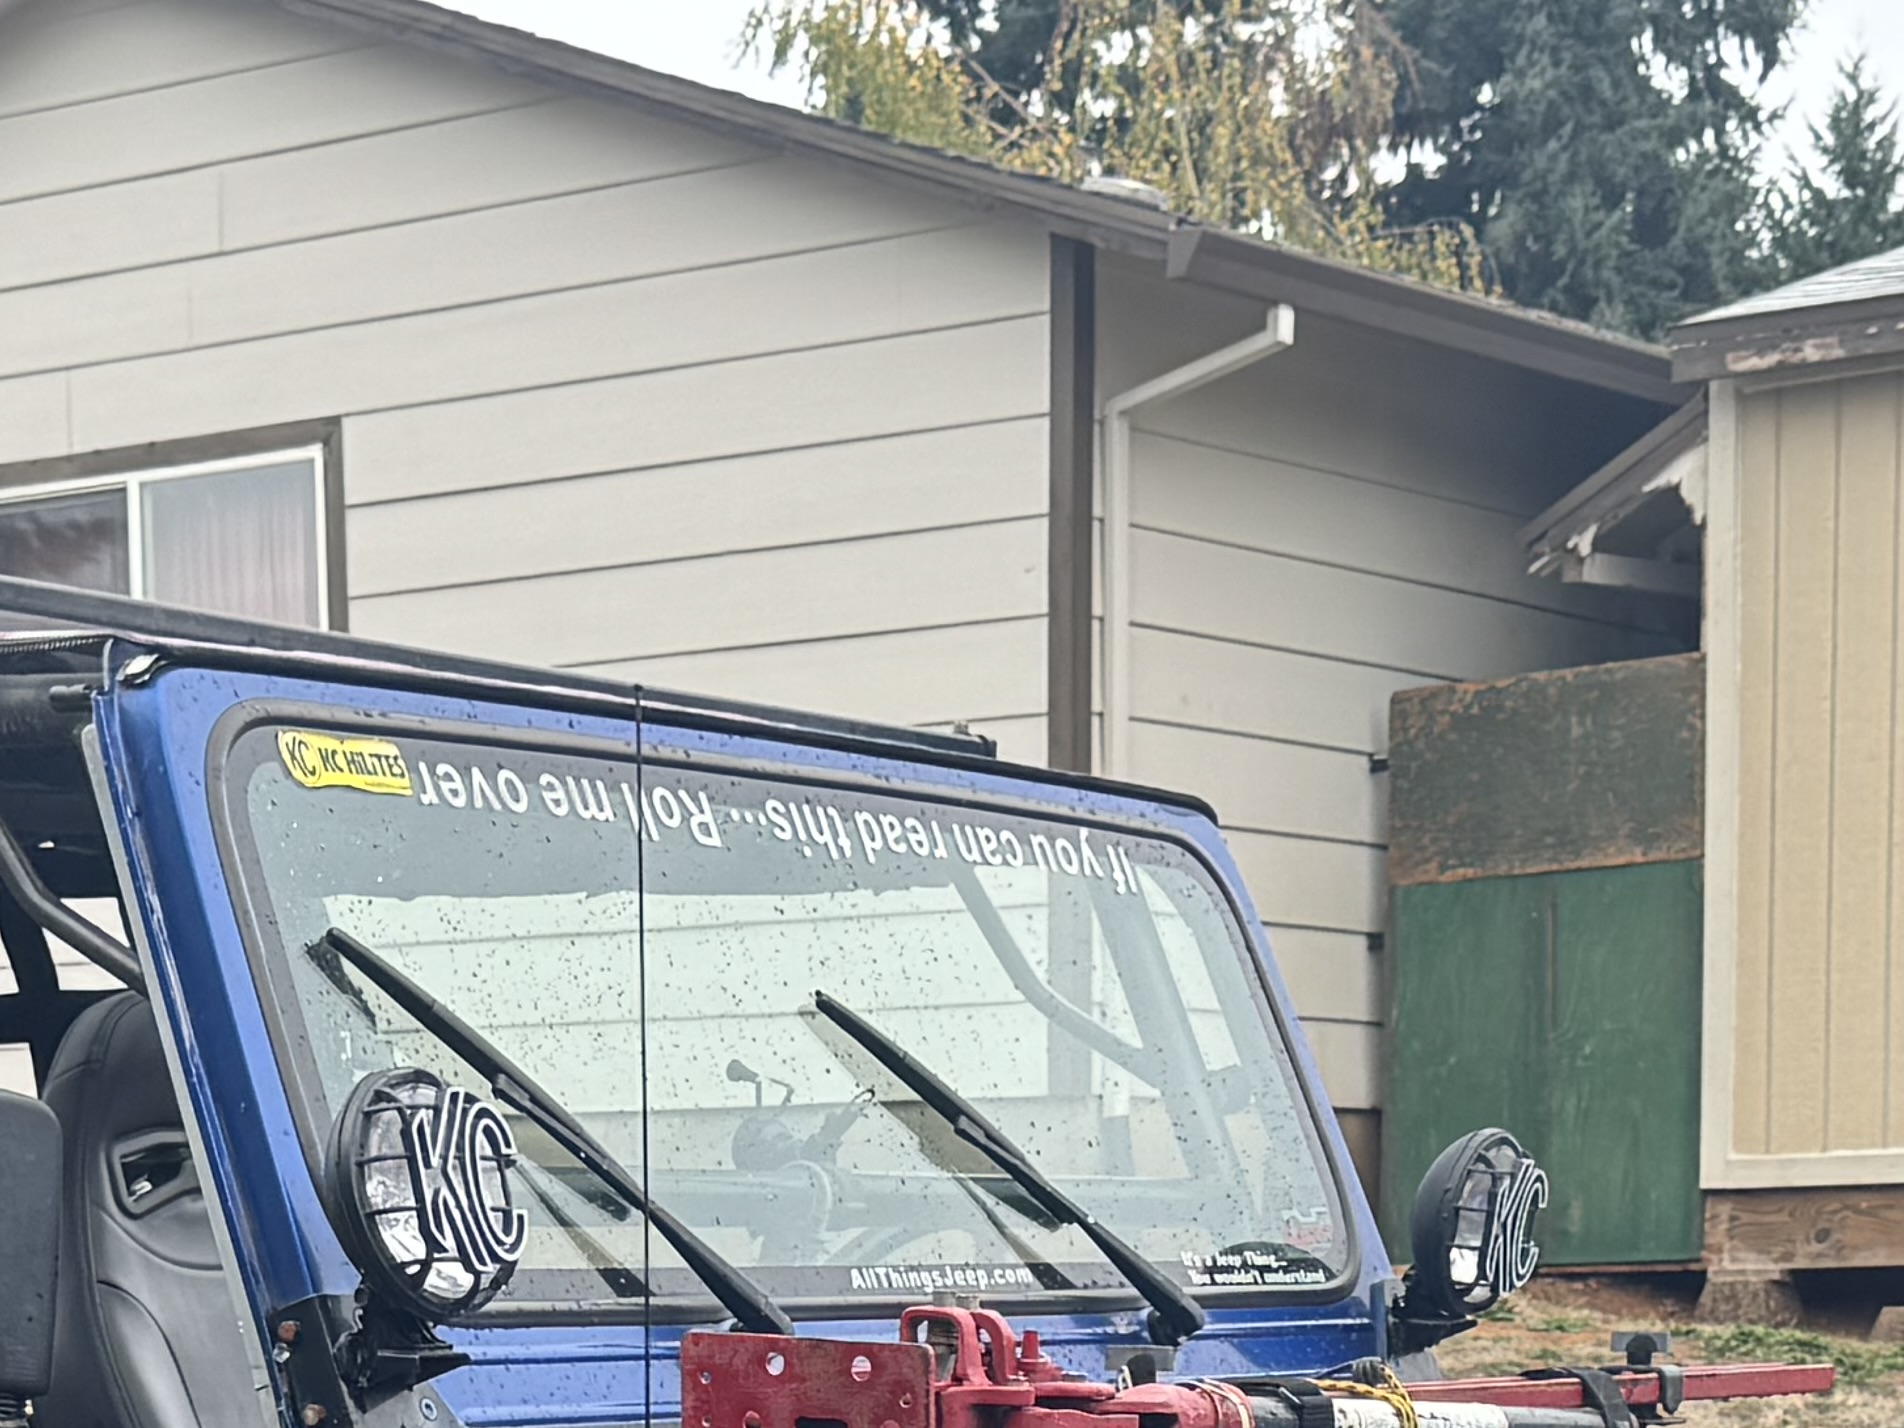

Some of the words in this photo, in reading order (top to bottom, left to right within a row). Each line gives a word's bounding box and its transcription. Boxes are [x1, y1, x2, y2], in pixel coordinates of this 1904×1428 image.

[286, 736, 316, 778] KC
[318, 747, 343, 773] KC
[417, 760, 528, 814] over
[538, 772, 614, 823] me
[620, 782, 723, 848] Roll
[854, 809, 947, 863] read
[952, 823, 1023, 866] can
[1031, 828, 1103, 879] you
[1106, 845, 1137, 894] If
[412, 1087, 528, 1271] KC
[1486, 1158, 1548, 1297] KC
[850, 1267, 1034, 1293] AllThingsJeep.com
[1215, 1251, 1242, 1267] Jeep
[1263, 1268, 1326, 1284] understand
